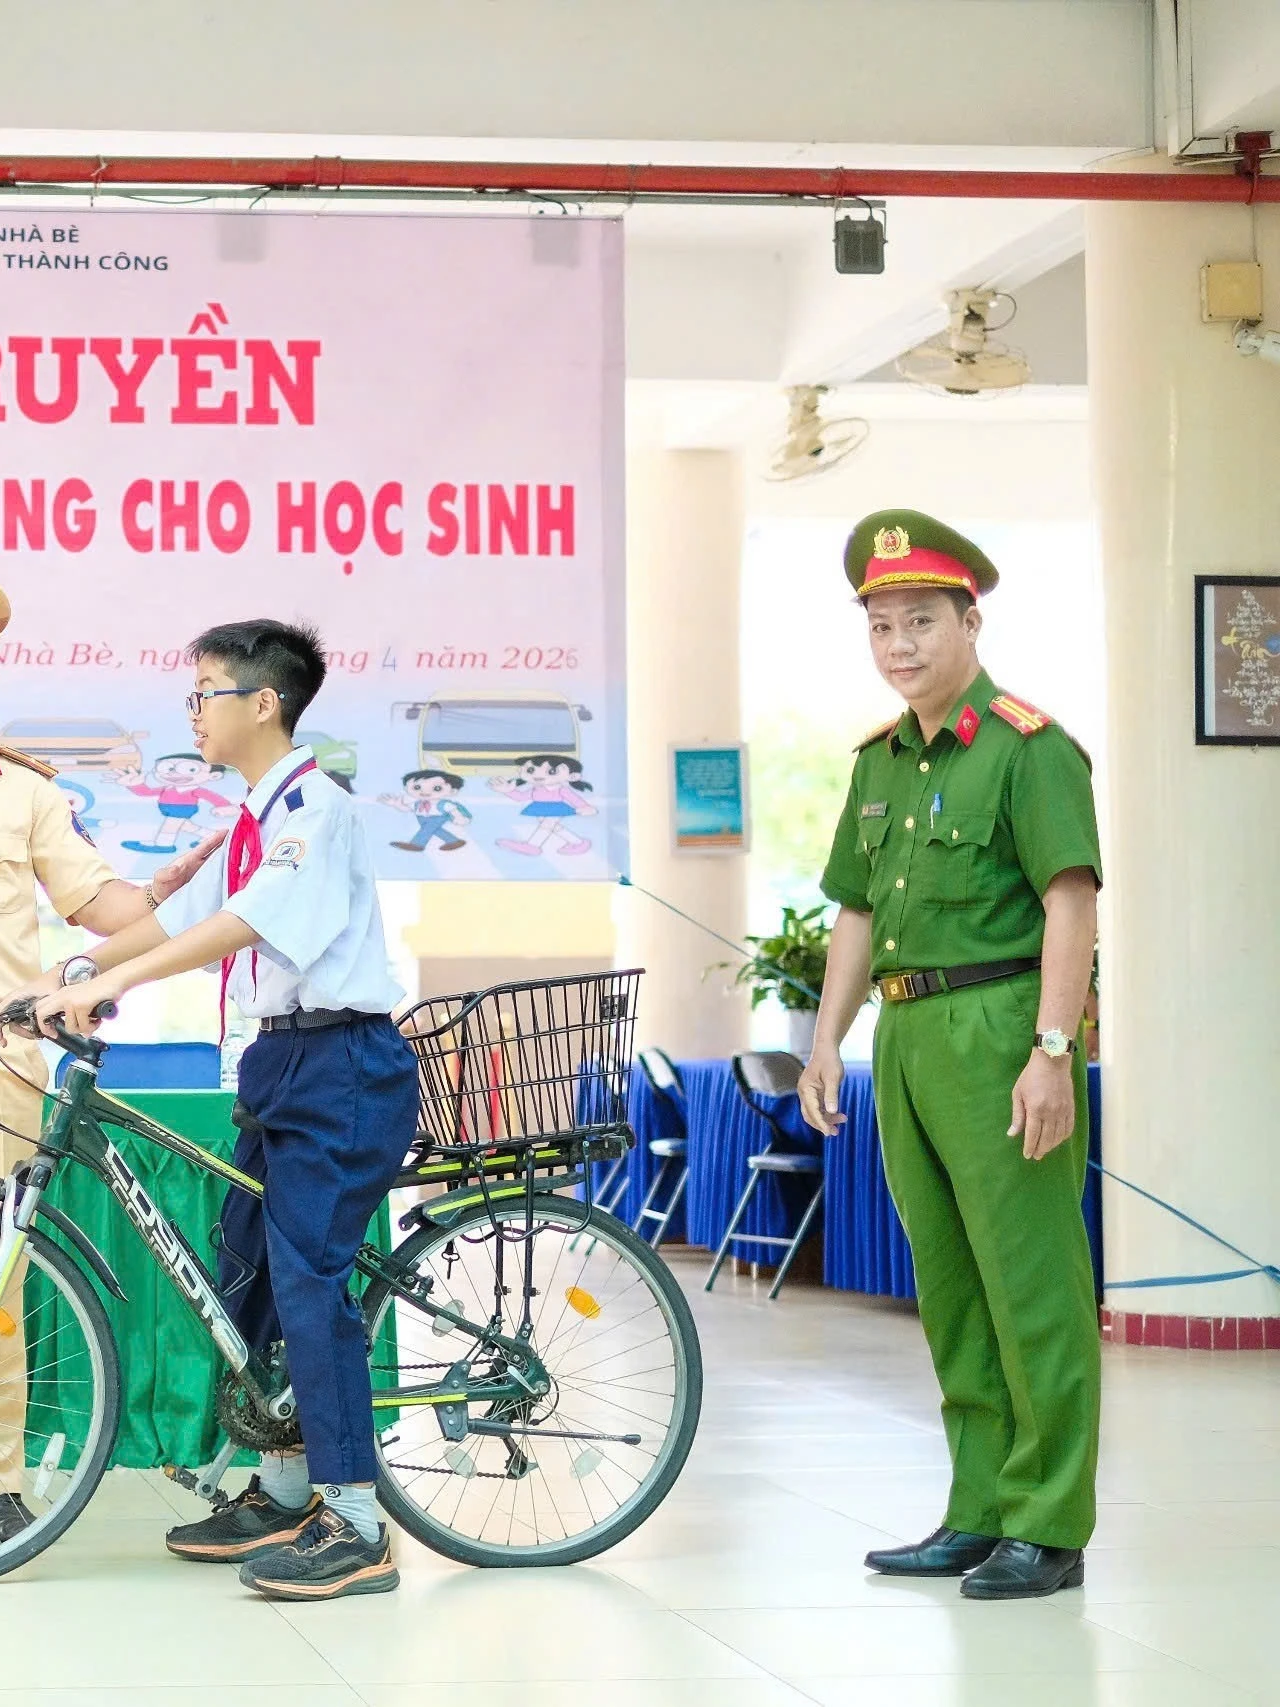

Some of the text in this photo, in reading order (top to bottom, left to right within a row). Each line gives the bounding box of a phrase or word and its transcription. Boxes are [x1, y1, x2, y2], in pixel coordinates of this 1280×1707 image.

[52, 224, 80, 243] BÈ
[3, 248, 91, 270] THÀNH
[98, 250, 169, 272] CÔNG
[120, 478, 252, 554] CHO
[276, 480, 404, 576] HỌC
[426, 481, 576, 558] SINH
[380, 645, 399, 672] 4
[415, 644, 489, 670] năm
[106, 1141, 246, 1368] COYOTE
